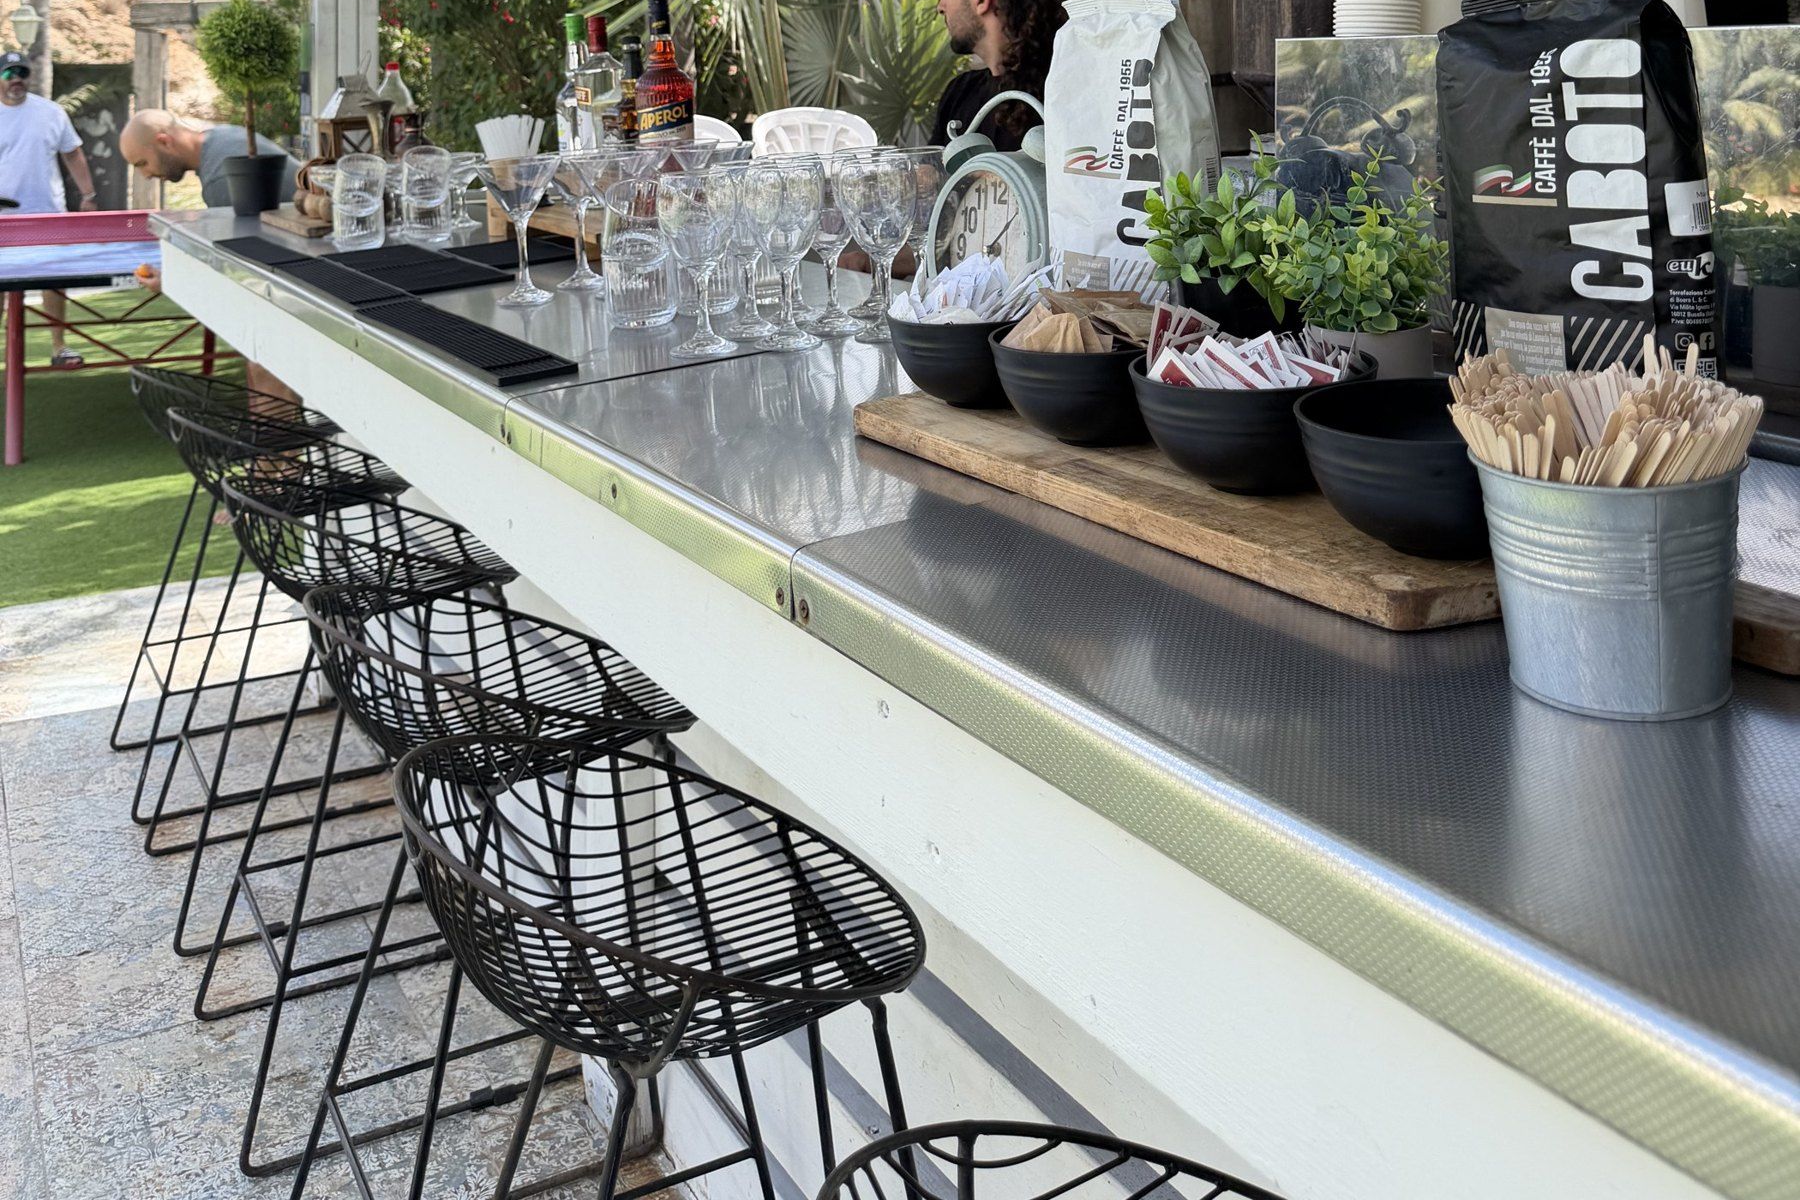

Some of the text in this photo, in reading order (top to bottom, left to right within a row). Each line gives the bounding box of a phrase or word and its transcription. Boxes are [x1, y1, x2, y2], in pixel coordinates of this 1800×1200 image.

[640, 104, 689, 131] APEROL
[1109, 58, 1132, 170] CAFFÈ DAL 1955
[1529, 93, 1556, 128] DAL
[1529, 136, 1556, 194] CAFFÈ
[1559, 38, 1654, 302] CABOTO
[975, 183, 988, 211] 11
[991, 180, 1008, 205] 12
[961, 206, 978, 234] 10
[956, 232, 967, 261] 9
